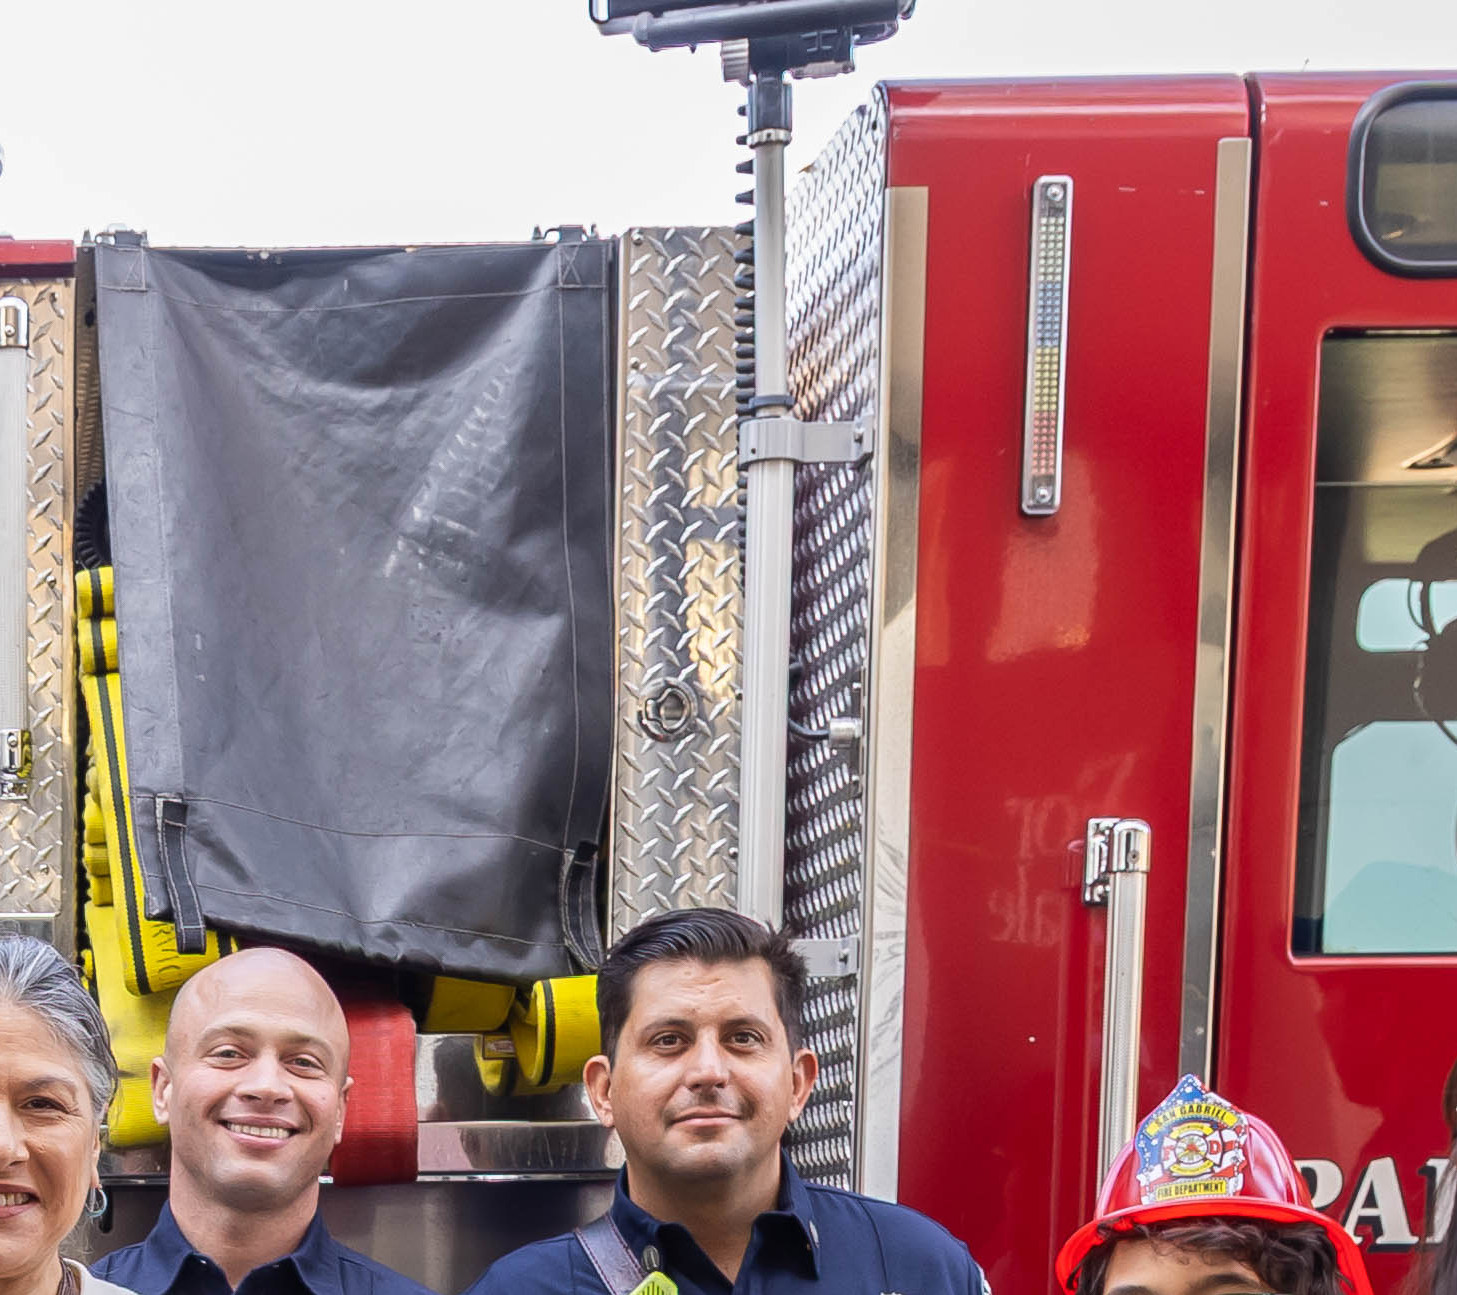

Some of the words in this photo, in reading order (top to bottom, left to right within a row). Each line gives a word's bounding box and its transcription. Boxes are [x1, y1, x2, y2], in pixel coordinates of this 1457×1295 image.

[1180, 1104, 1225, 1121] GABRIEL
[1157, 1187, 1173, 1198] FIRE
[1175, 1182, 1225, 1195] DEPARTMENT
